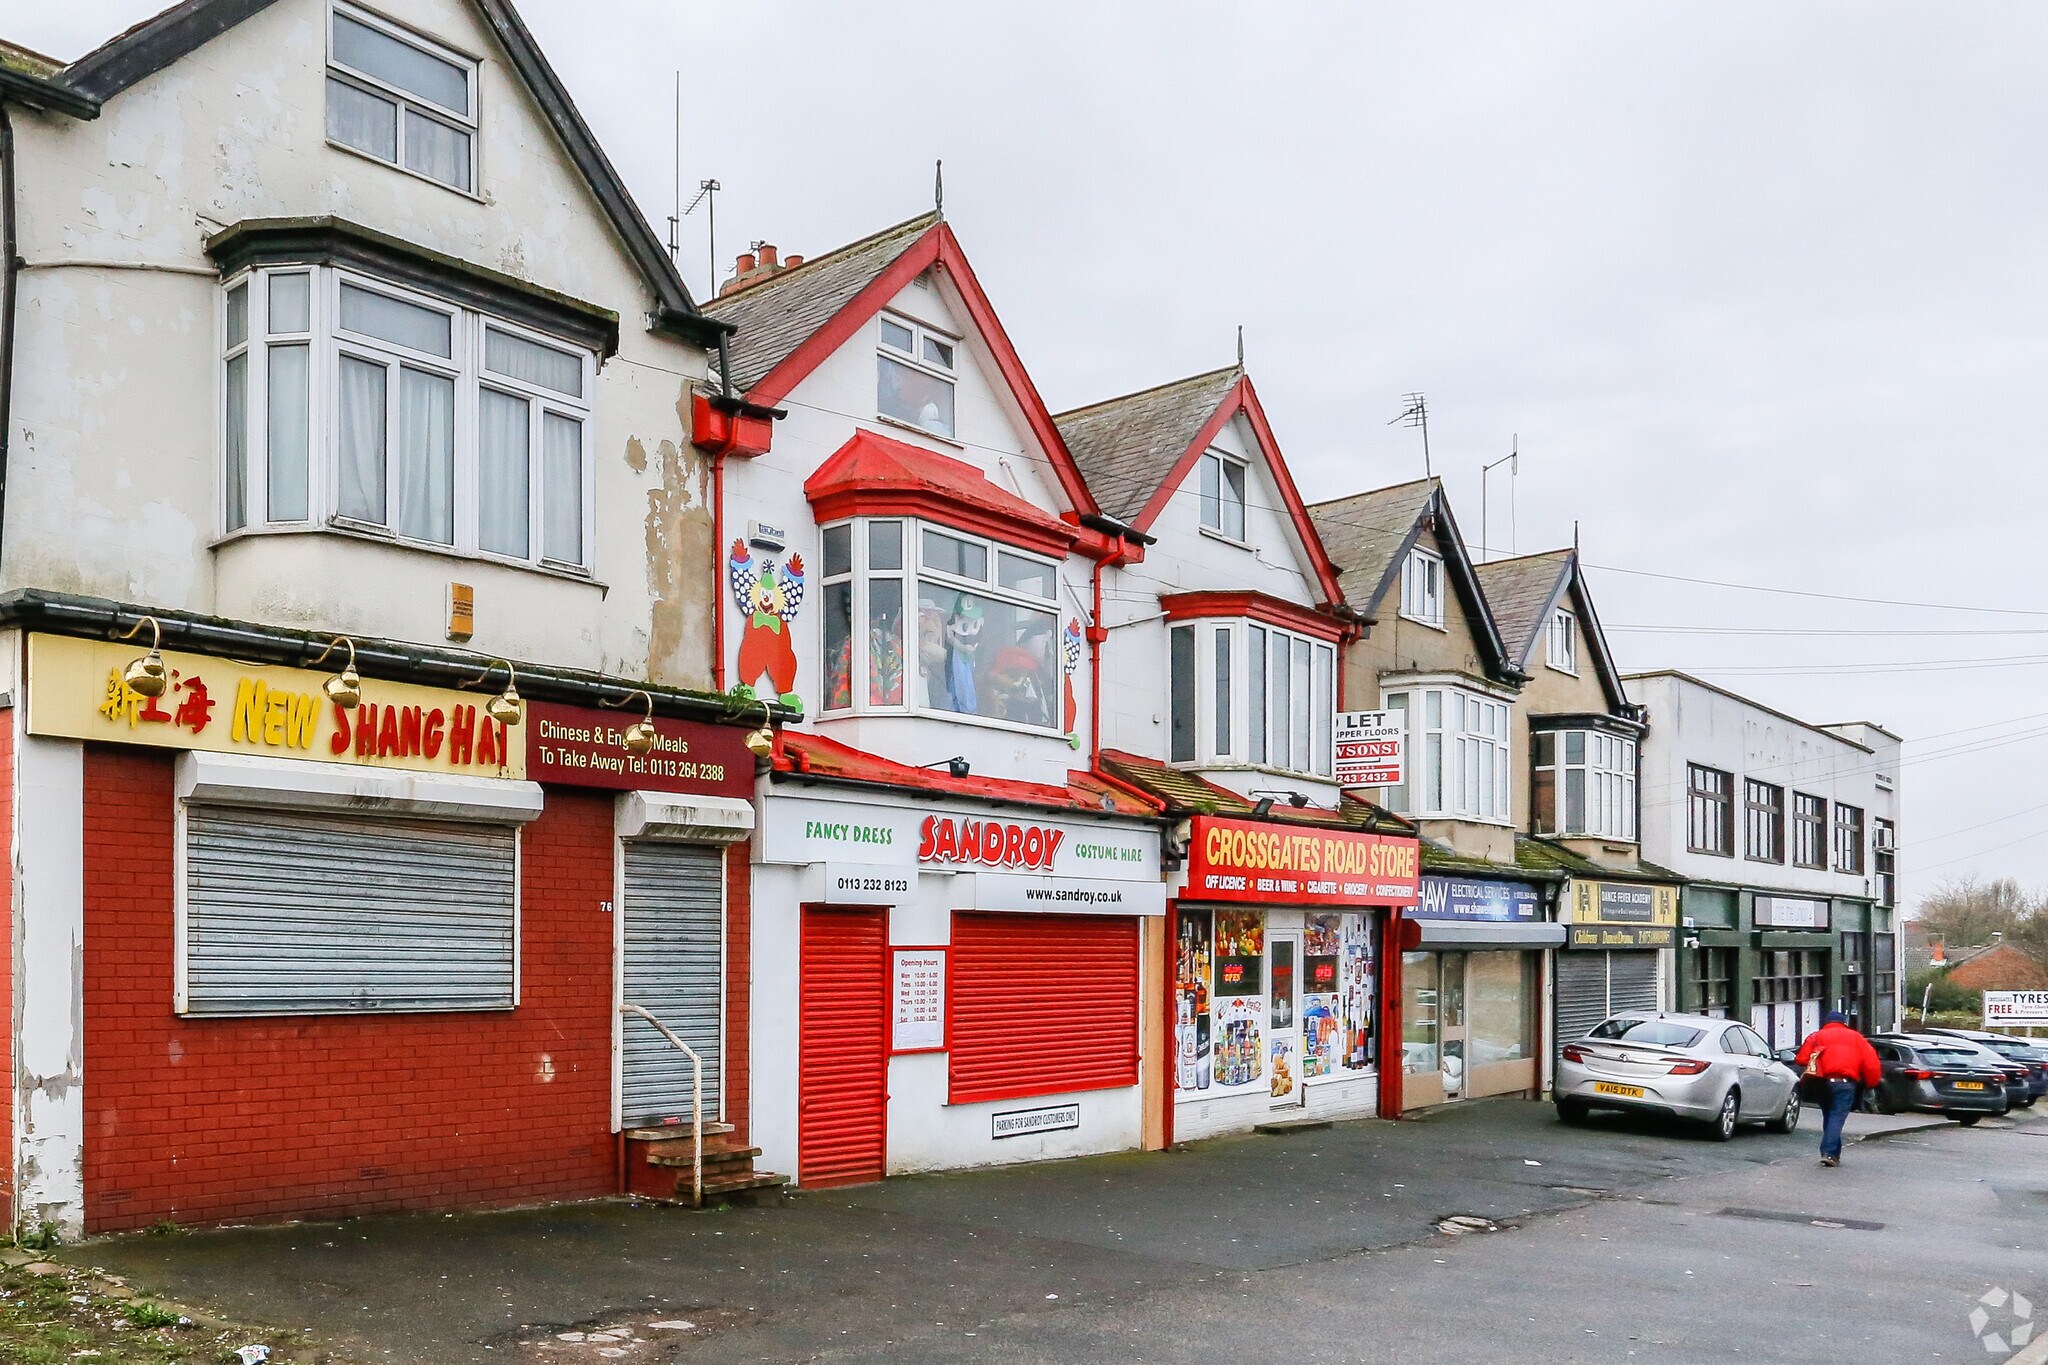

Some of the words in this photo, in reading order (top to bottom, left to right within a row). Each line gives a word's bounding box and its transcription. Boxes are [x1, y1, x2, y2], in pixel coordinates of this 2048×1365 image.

[231, 676, 322, 749] NEW
[1346, 713, 1386, 728] LET
[539, 719, 590, 743] Chinese
[593, 726, 604, 745] &
[653, 733, 689, 754] Meals
[1364, 727, 1399, 737] FLOORS
[538, 745, 555, 765] To
[557, 748, 587, 768] Take
[589, 751, 625, 776] Away
[626, 755, 648, 775] Tel:
[650, 758, 676, 777] 0113
[678, 762, 698, 779] 264
[700, 764, 725, 782] 2388
[1360, 772, 1388, 782] 2432
[805, 821, 850, 841] FANCY
[852, 825, 893, 846] DRESS
[917, 814, 1066, 872] SANDROY
[1075, 843, 1118, 861] COSTUME
[1120, 847, 1143, 862] HIRE
[1206, 826, 1321, 873] CROSSGATES
[1323, 839, 1367, 875] ROAD
[1369, 843, 1415, 878] STORE
[837, 877, 861, 890] 0113
[863, 878, 882, 891] 232
[884, 879, 908, 892] 8123
[1205, 874, 1219, 889] OFF
[1218, 875, 1247, 891] LICENCE
[1257, 878, 1275, 892] BEER
[1275, 879, 1281, 892] &
[1281, 880, 1298, 893] WINE
[1307, 880, 1337, 895] CIGARETTE
[1343, 882, 1368, 896] GROCERY
[1451, 883, 1485, 899] ELECTRICAL
[1484, 886, 1510, 900] SERVICES
[1026, 888, 1122, 905] www.sandroy.co.uk
[1407, 880, 1449, 912] HAW
[600, 901, 612, 912] 76
[900, 959, 922, 968] Opening
[923, 958, 938, 966] Hours
[2012, 993, 2048, 1004] TYRES
[1988, 1004, 2013, 1014] FREE
[1600, 1083, 1618, 1094] VA15
[1621, 1088, 1638, 1096] DTK
[996, 1118, 1014, 1131] PARKING
[1015, 1116, 1024, 1129] FOR
[1024, 1114, 1043, 1128] SANDROY
[1043, 1111, 1066, 1125] CUSTOMERS
[1066, 1110, 1076, 1122] ONLY
